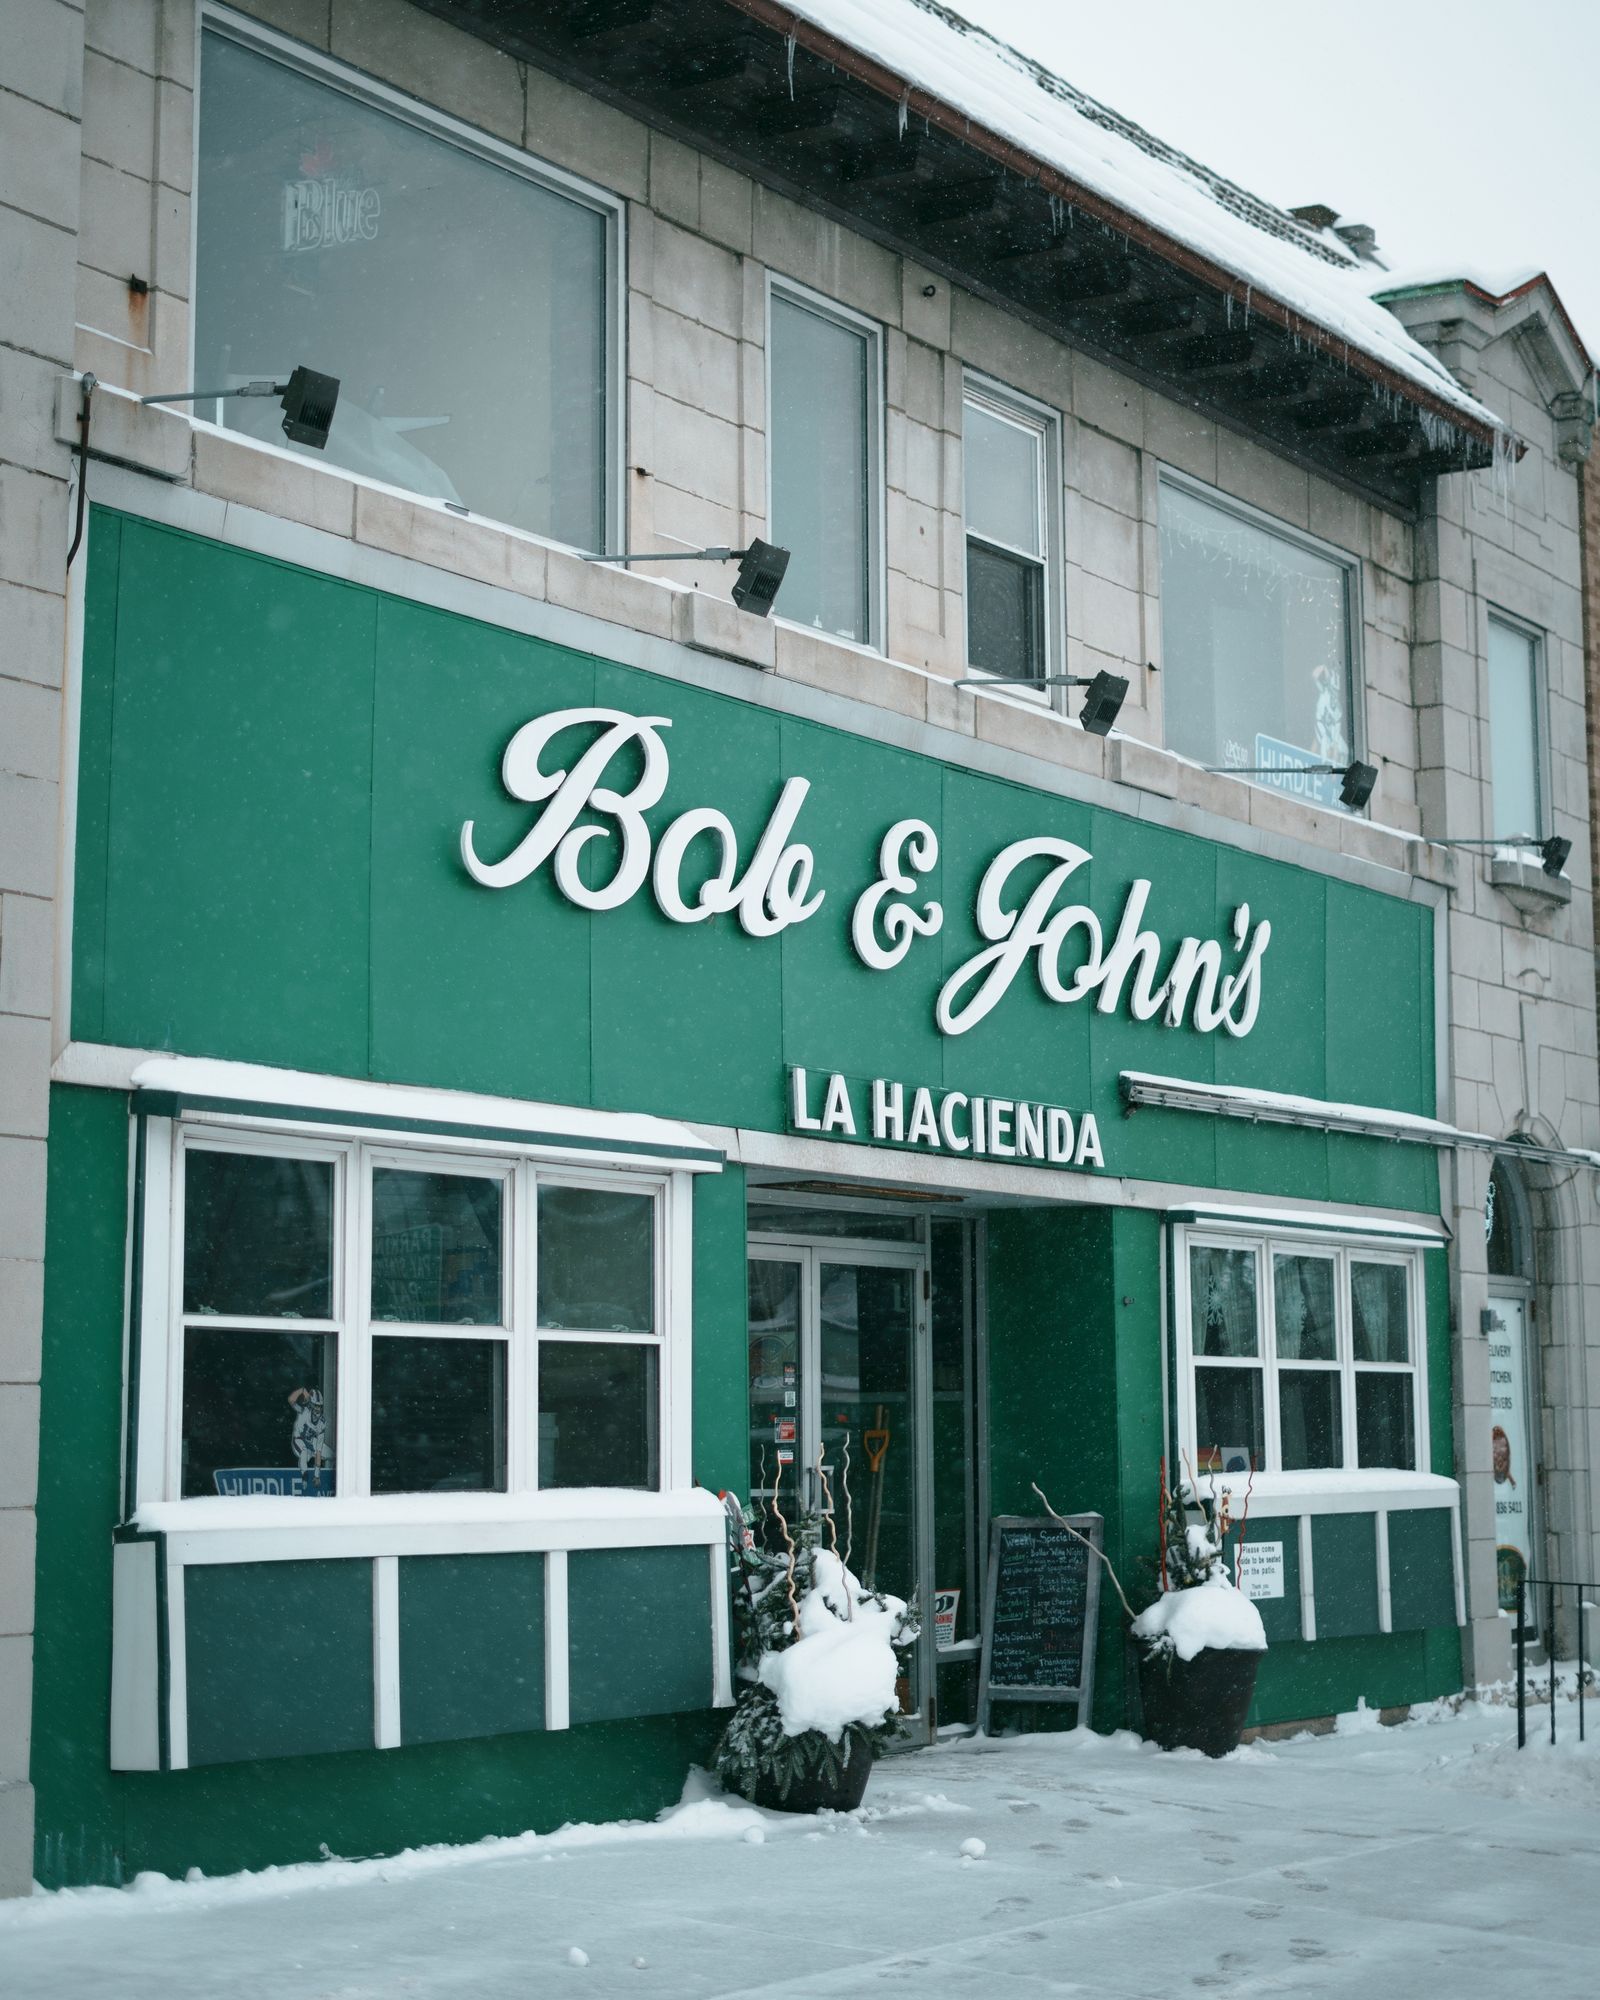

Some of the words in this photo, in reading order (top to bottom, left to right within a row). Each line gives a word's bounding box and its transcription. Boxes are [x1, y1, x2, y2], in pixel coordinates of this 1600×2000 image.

[285, 178, 380, 250] Blue
[1260, 746, 1323, 801] HURDLE
[460, 707, 825, 938] Bob
[852, 818, 943, 971] &
[936, 836, 1272, 1038] John's
[792, 1066, 858, 1135] LA
[871, 1078, 1105, 1168] HACIENDA
[1489, 1345, 1511, 1357] ELIVERY
[1490, 1371, 1512, 1383] ITCHEN
[1490, 1397, 1512, 1409] ERVERS
[1266, 1555, 1281, 1563] seated
